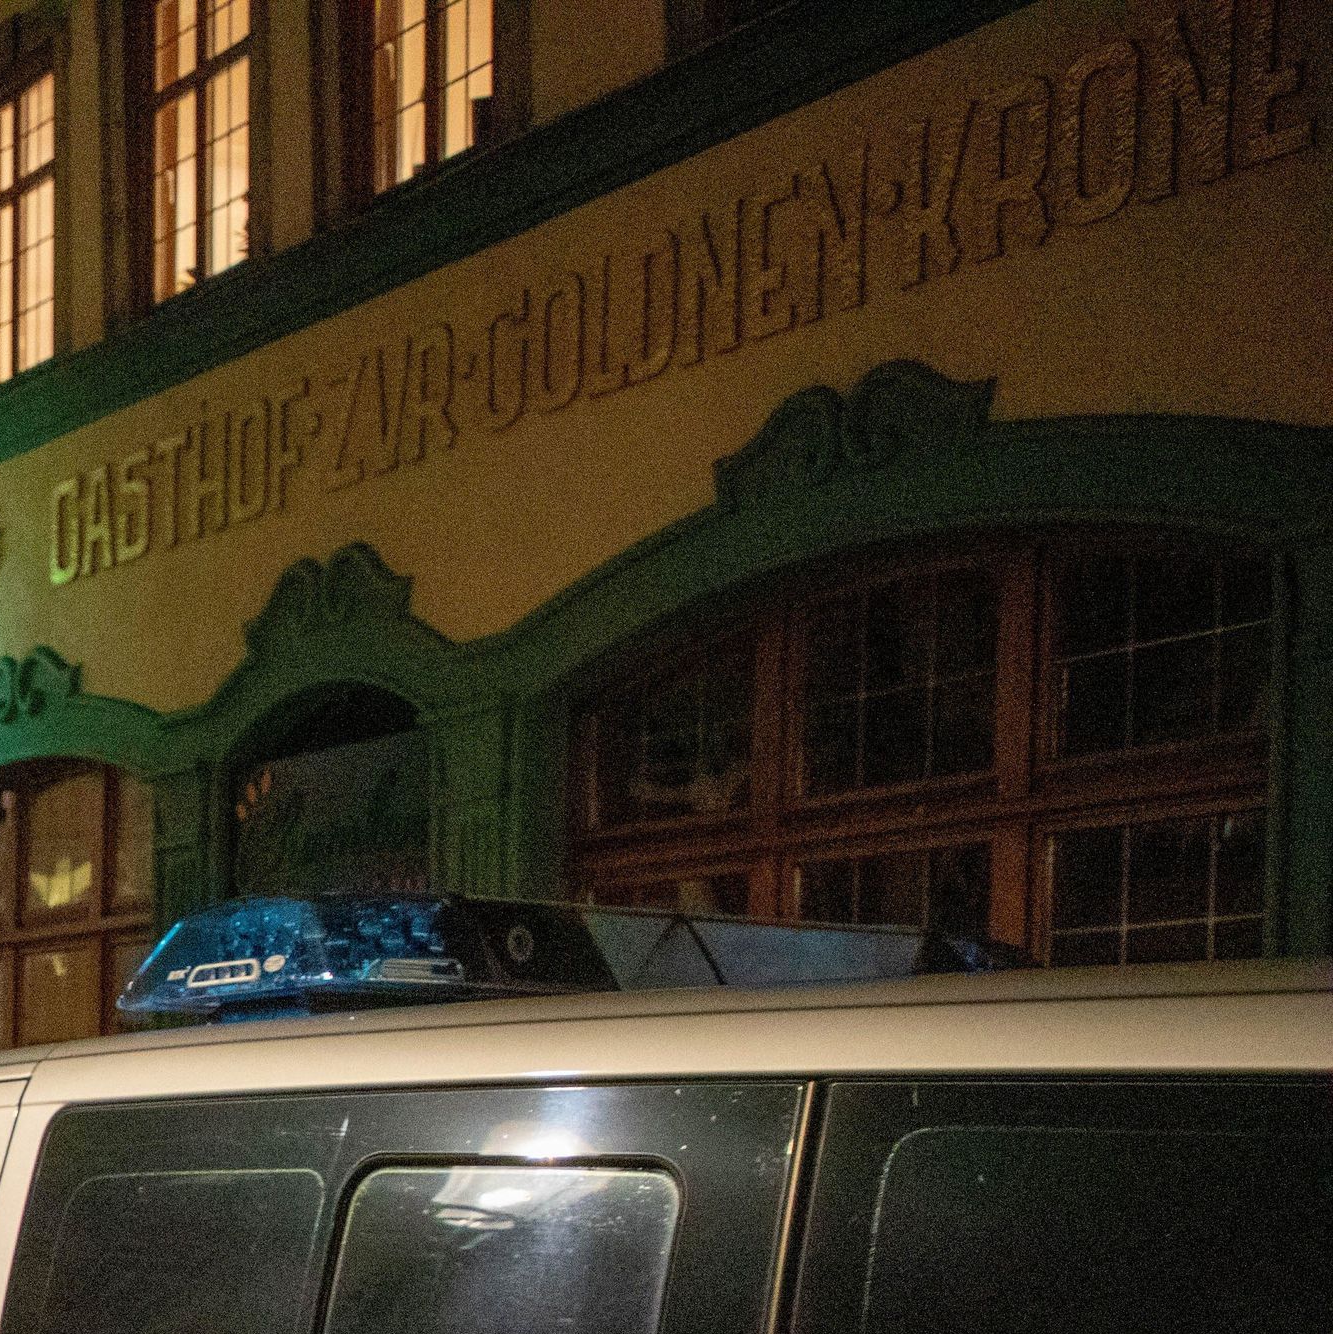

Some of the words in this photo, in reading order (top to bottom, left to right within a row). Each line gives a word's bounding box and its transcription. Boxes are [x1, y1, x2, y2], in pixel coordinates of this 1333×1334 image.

[48, 376, 313, 585] GASTHOF
[485, 140, 873, 434] GOLDNEN
[899, 0, 1319, 291] KRONE
